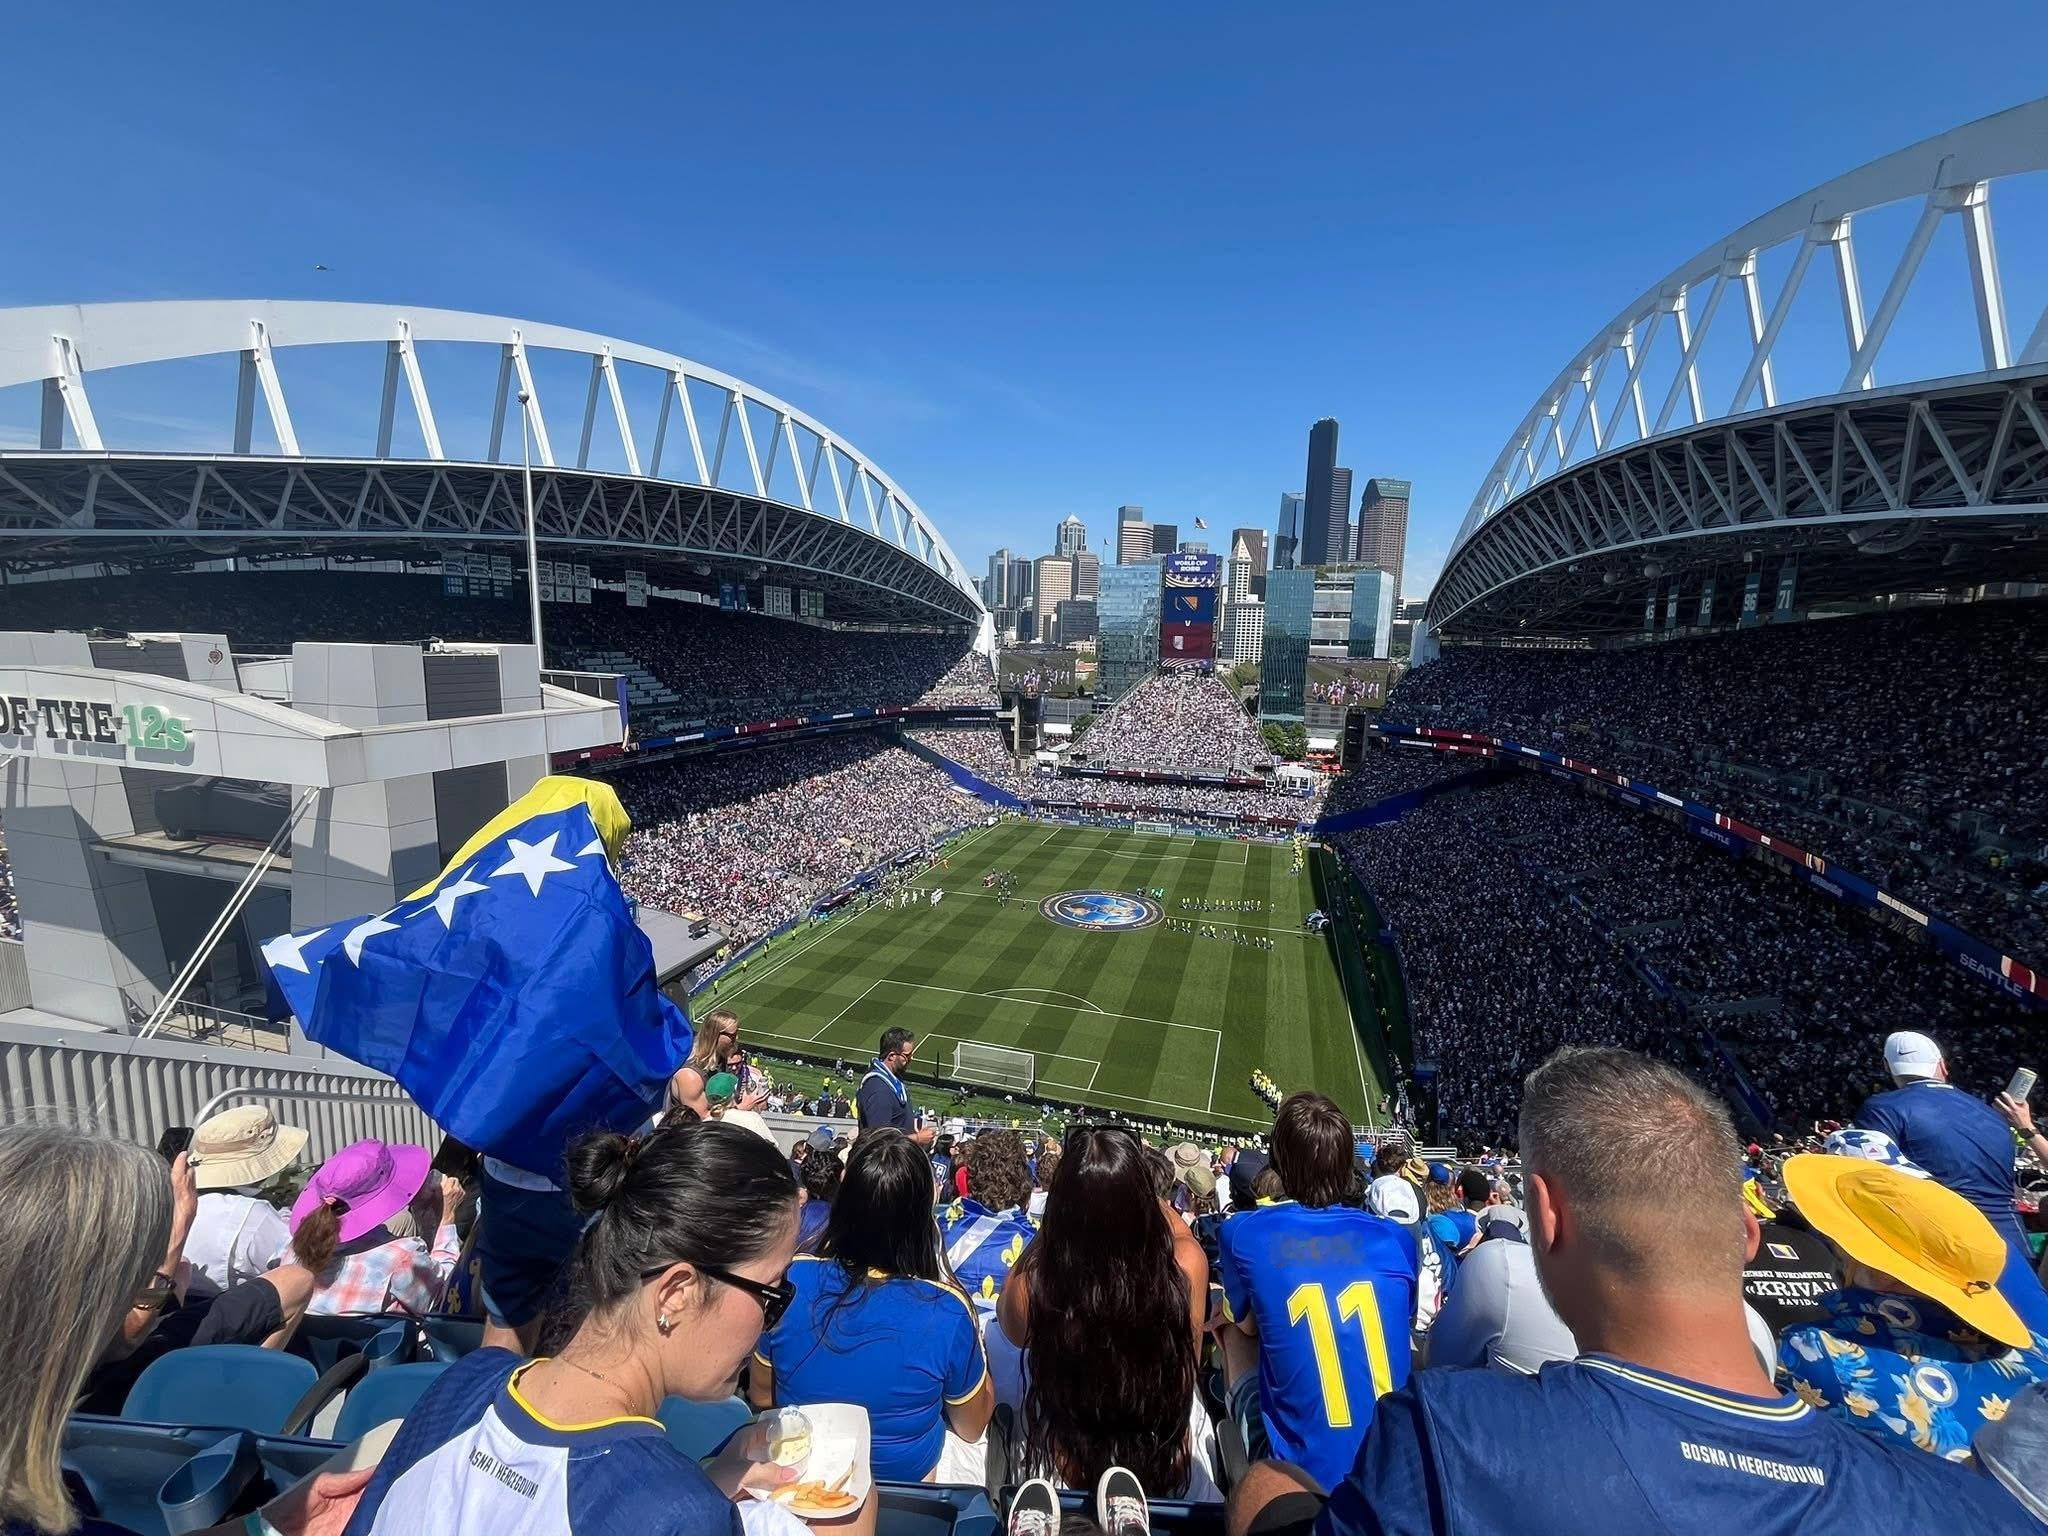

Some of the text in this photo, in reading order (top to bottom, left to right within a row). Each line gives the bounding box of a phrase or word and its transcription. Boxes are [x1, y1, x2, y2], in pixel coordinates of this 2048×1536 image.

[1701, 597, 1712, 614] 12
[1778, 590, 1791, 609] 71
[36, 698, 118, 744] THE
[1700, 826, 1731, 846] SEATTLE
[1959, 952, 2024, 998] SEATTLE
[1286, 1280, 1394, 1428] 11
[1680, 1441, 1730, 1468] BOSNA
[1729, 1452, 1737, 1470] I
[495, 1463, 539, 1501] HERCEGOVINA
